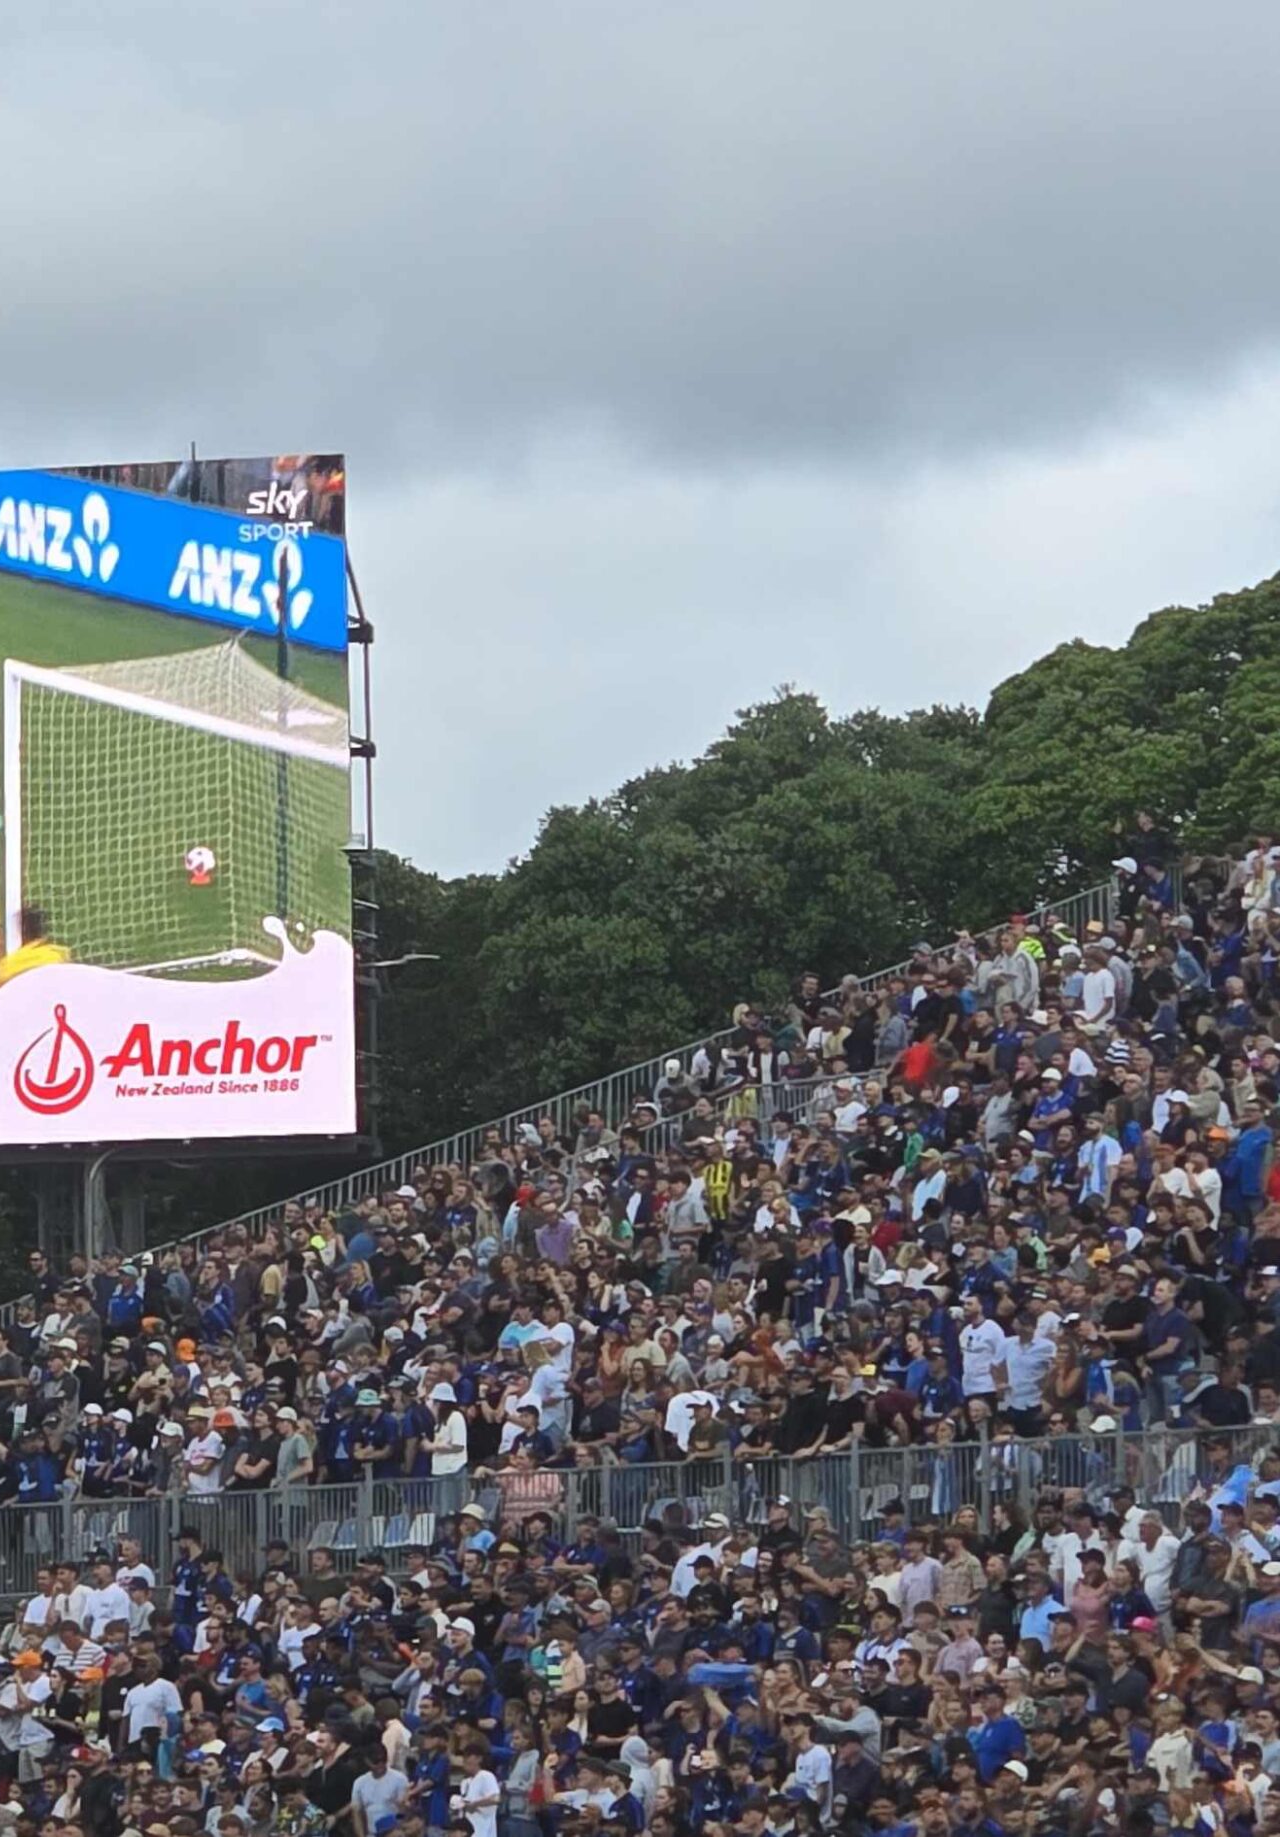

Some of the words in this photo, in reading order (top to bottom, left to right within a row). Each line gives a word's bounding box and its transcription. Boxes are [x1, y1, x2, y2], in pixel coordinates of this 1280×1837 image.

[238, 521, 314, 542] SPORT
[168, 540, 262, 619] ANZ
[99, 1020, 318, 1078] Anchor
[115, 1084, 148, 1098] New
[151, 1079, 214, 1096] Zealand
[218, 1077, 259, 1095] Since
[263, 1077, 300, 1093] 1886
